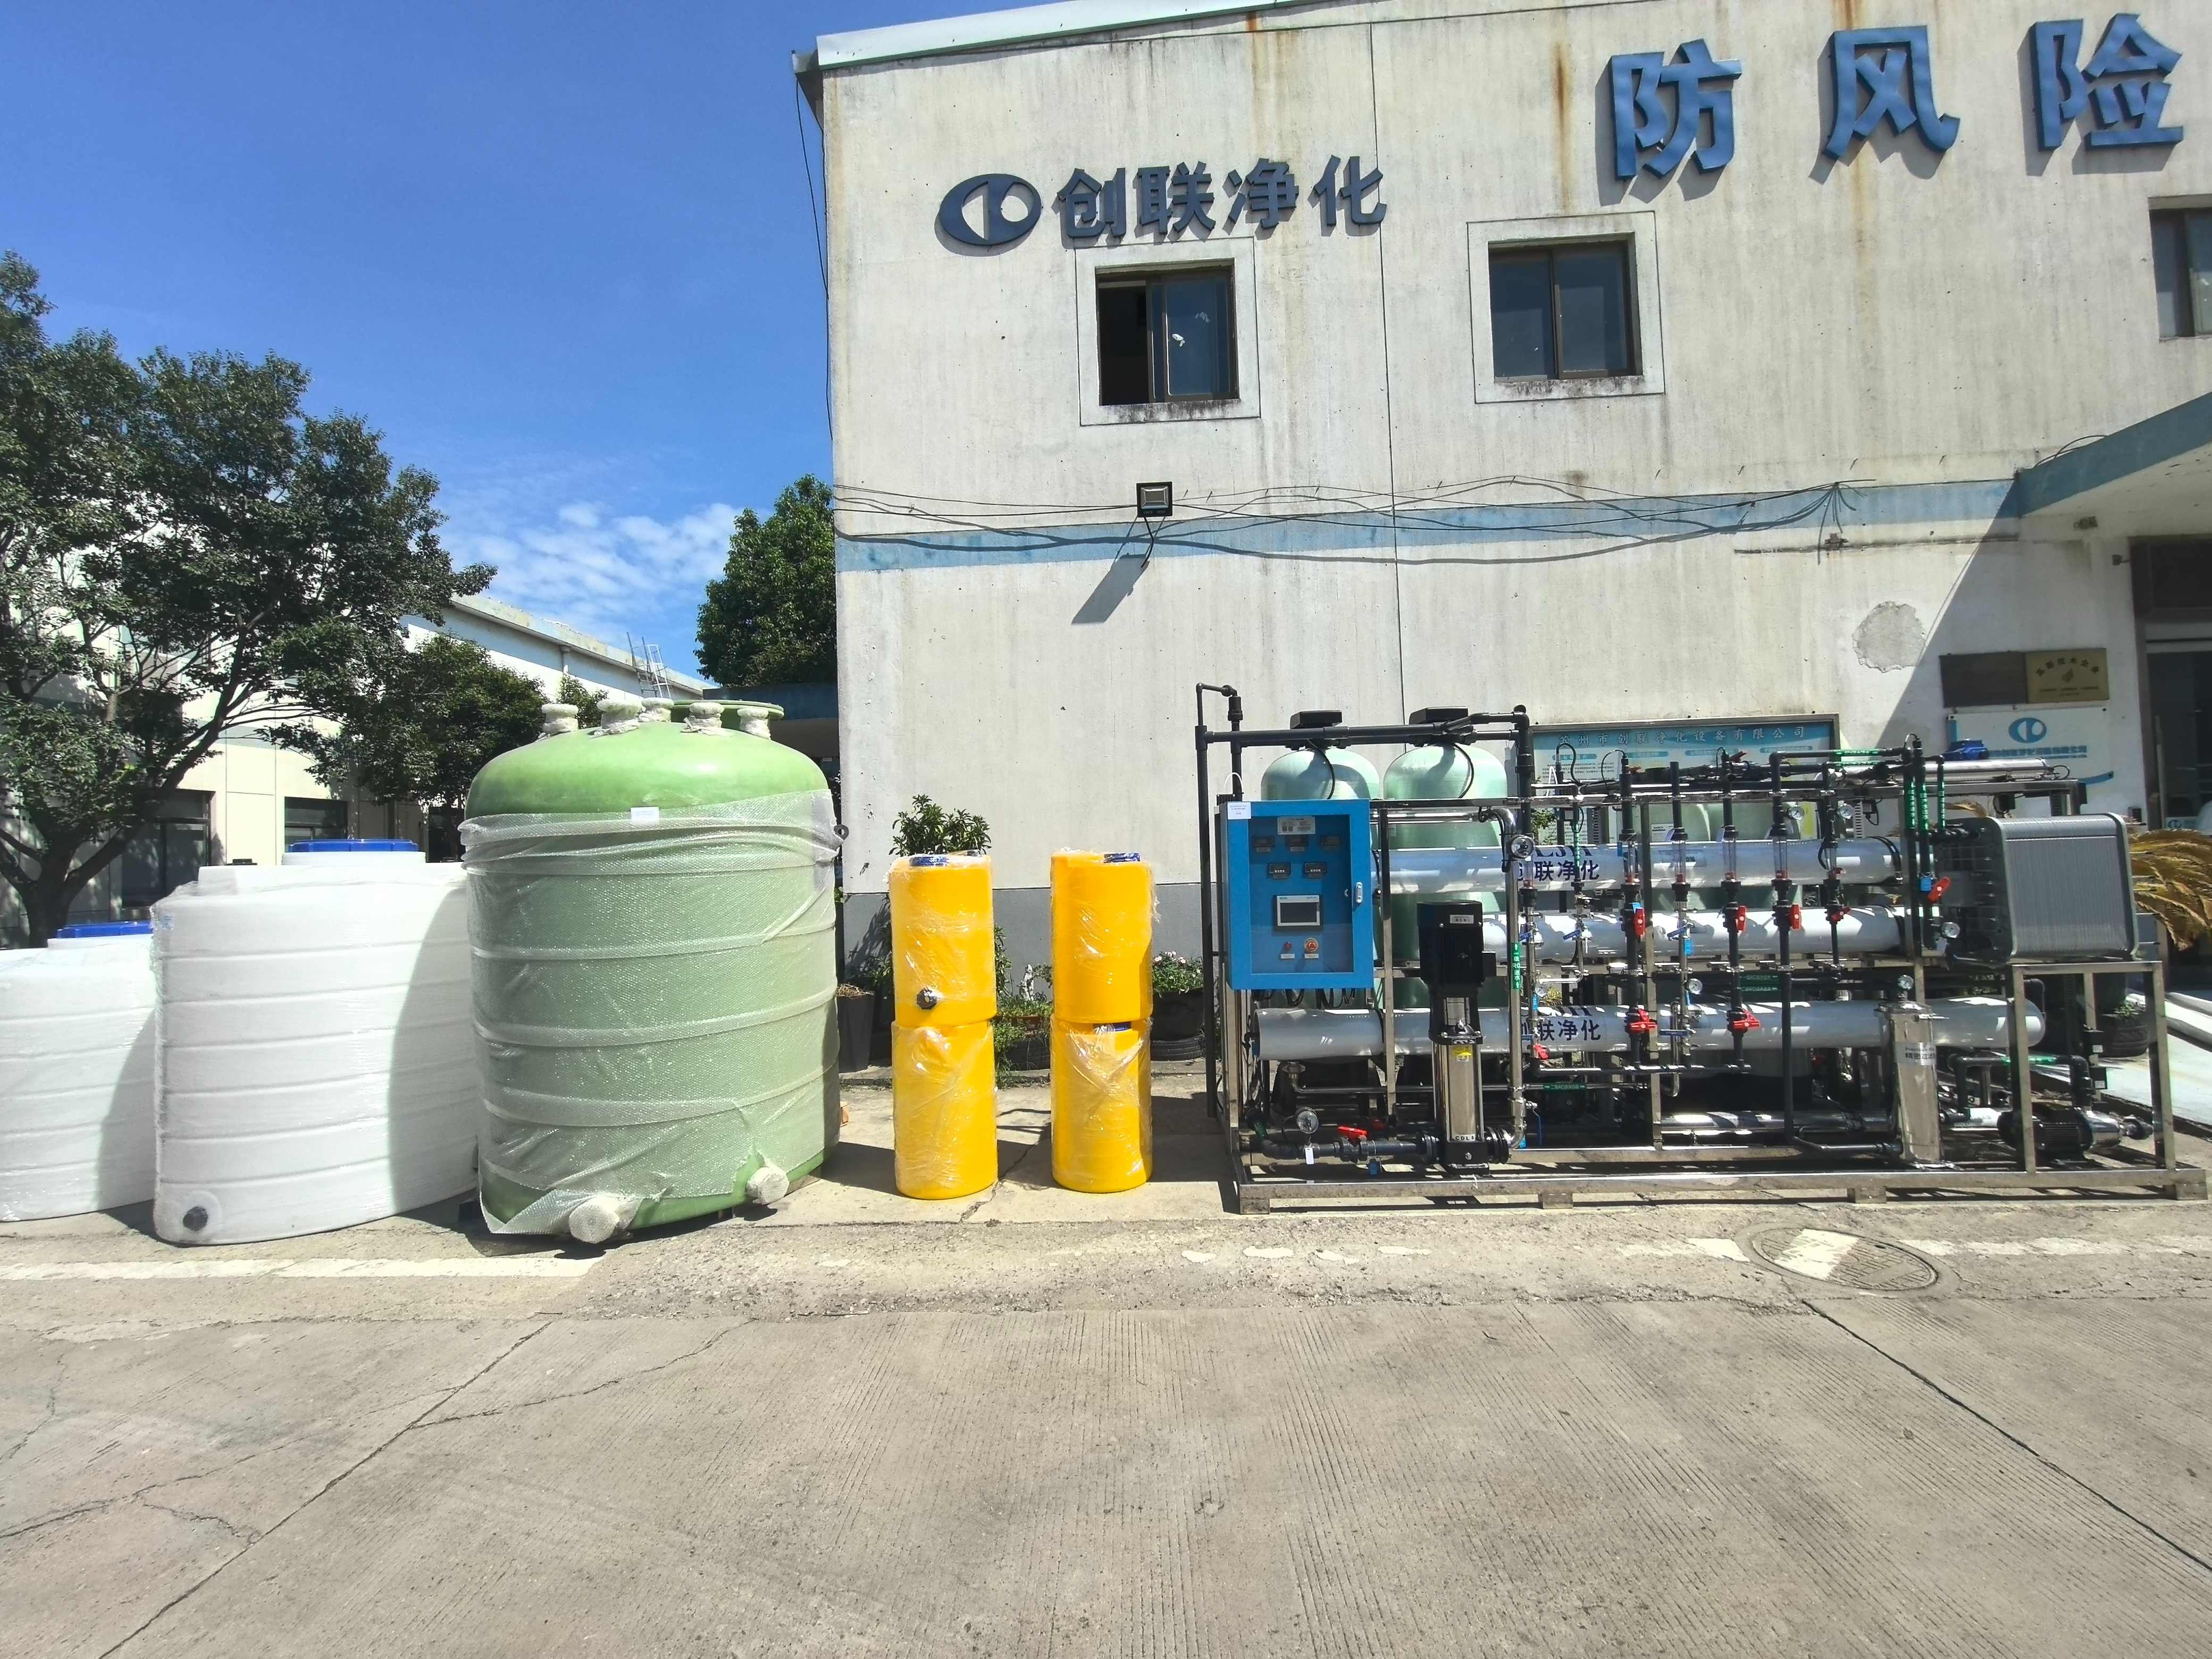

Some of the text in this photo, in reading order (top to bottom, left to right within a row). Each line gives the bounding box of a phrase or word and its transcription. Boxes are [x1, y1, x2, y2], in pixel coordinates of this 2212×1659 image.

[1610, 13, 2183, 180] 防风险
[1058, 155, 1387, 239] 创联净化
[1518, 860, 1599, 881] 联净化
[1522, 1019, 1601, 1041] 联净化
